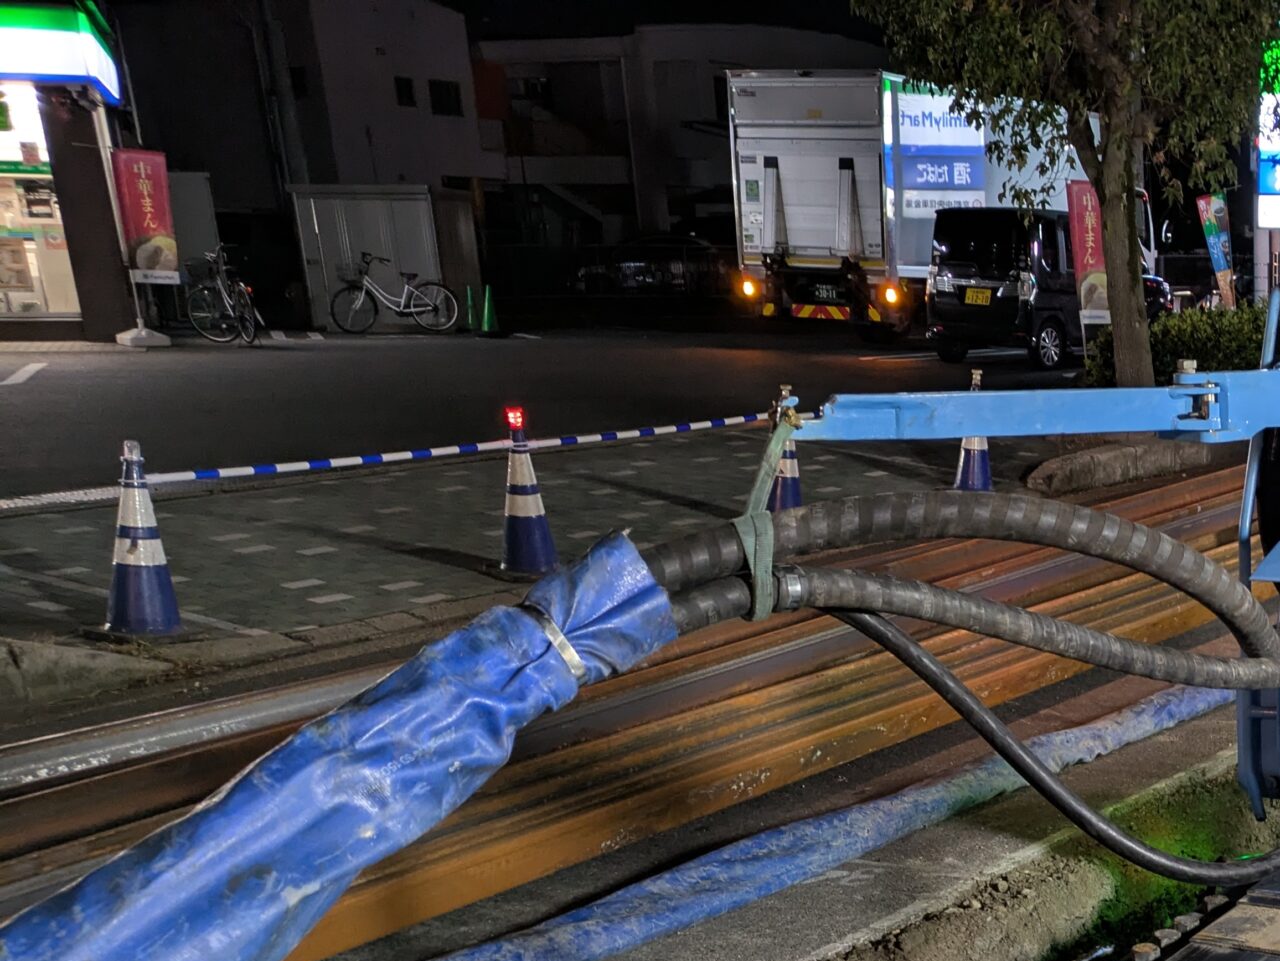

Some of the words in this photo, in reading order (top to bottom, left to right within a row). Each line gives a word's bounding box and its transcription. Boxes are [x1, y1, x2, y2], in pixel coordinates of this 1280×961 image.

[133, 161, 158, 228] 中華まん
[1083, 192, 1097, 264] 中華まん
